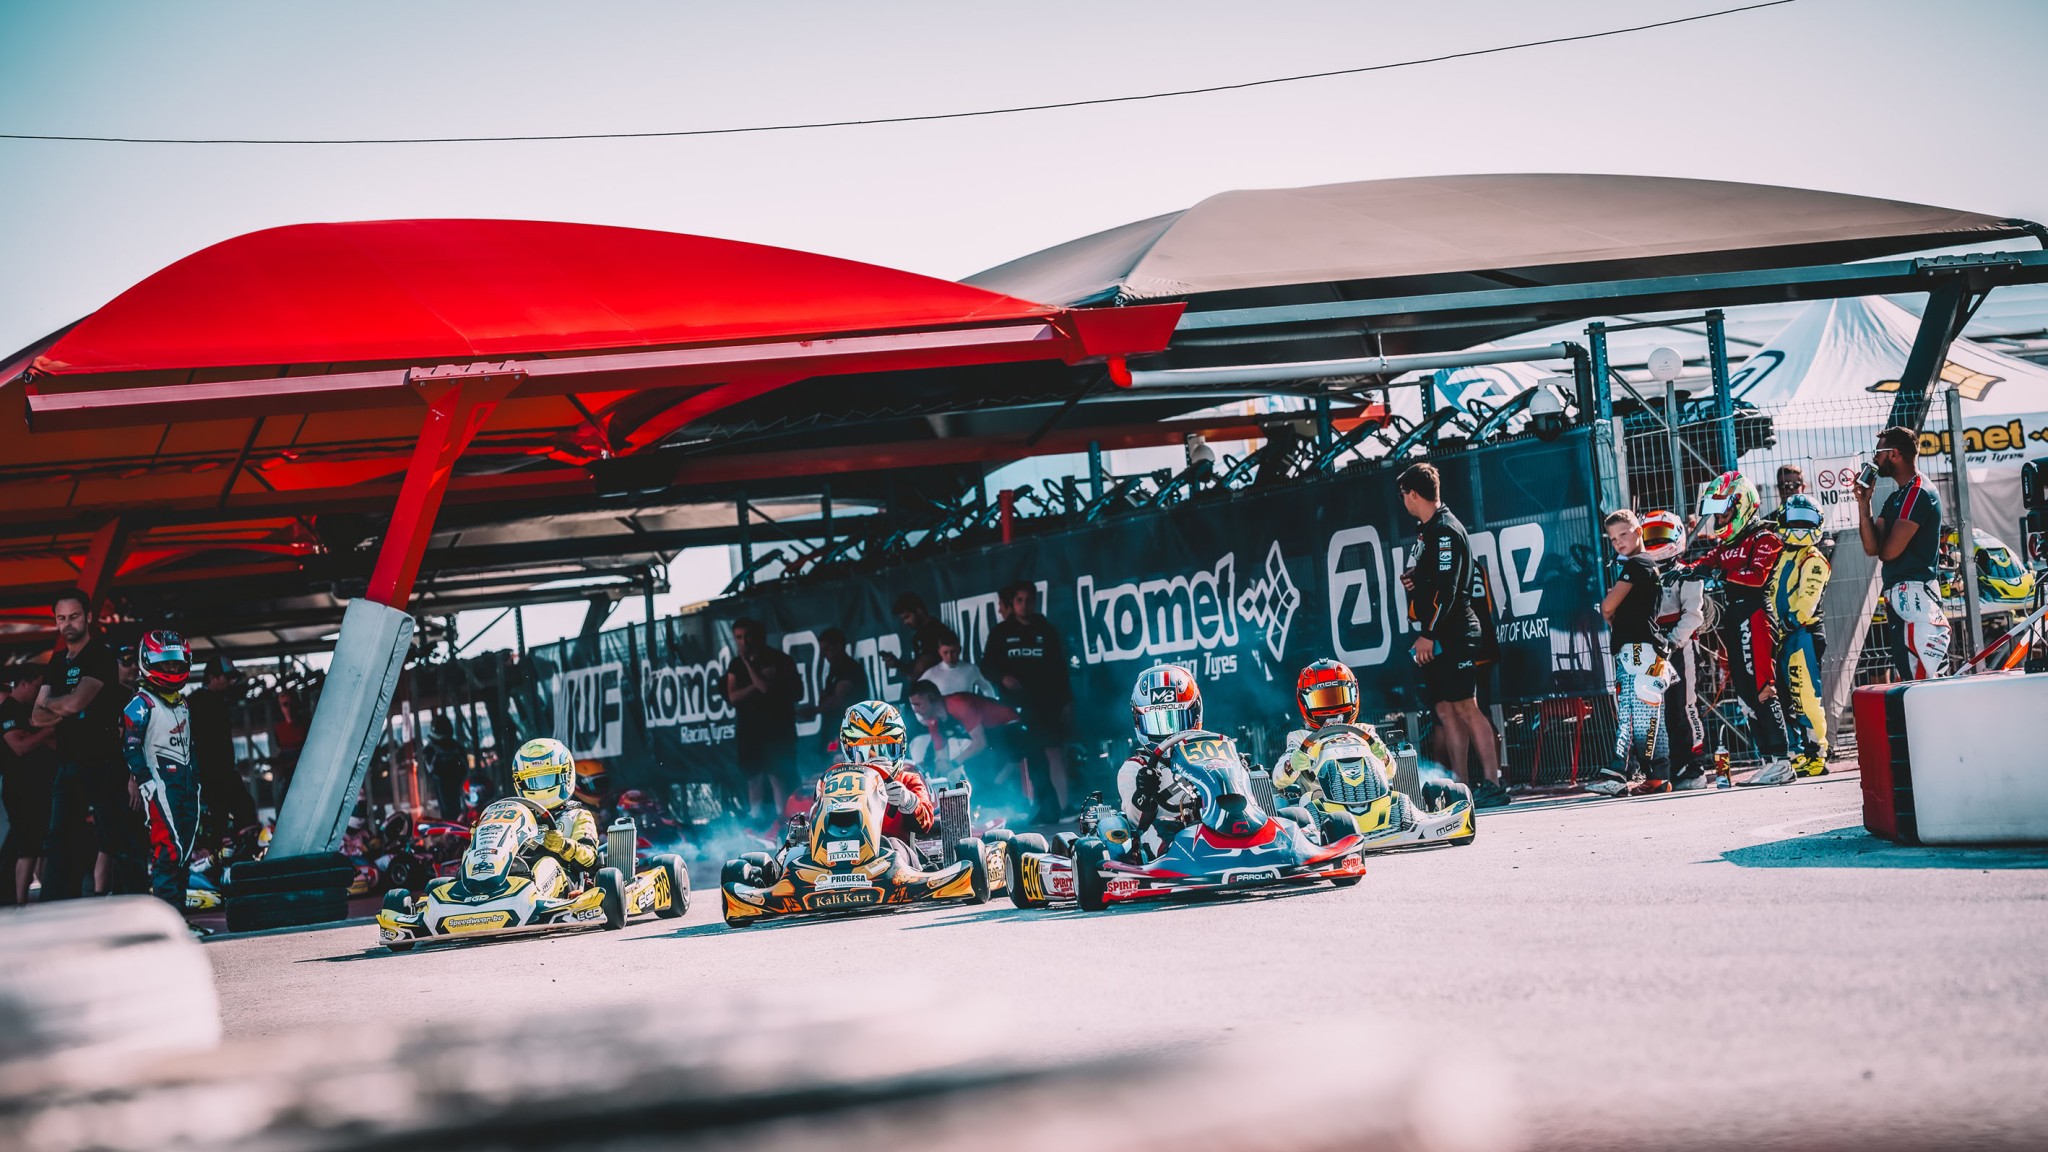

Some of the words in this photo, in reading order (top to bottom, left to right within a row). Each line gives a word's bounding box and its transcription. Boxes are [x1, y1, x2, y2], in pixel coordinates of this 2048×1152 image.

[1919, 418, 2026, 457] omet
[1991, 452, 2024, 462] Tyres
[1821, 489, 1838, 505] NO
[1077, 552, 1239, 664] komet
[1523, 617, 1550, 640] KART
[1203, 652, 1238, 681] Tyres
[681, 725, 712, 745] Racing
[710, 721, 735, 743] Tyres
[1184, 740, 1232, 762] 501
[825, 775, 865, 794] 541
[484, 809, 518, 820] 573
[829, 852, 859, 861] JELOMA
[831, 875, 866, 883] PROGESA
[1022, 857, 1041, 899] 501
[1053, 877, 1073, 889] SPIRIT
[1107, 879, 1140, 893] SPIRIT
[463, 894, 490, 903] EGP
[638, 886, 655, 909] EGP
[816, 896, 840, 907] Kali
[843, 894, 871, 904] Kart
[576, 908, 602, 921] EGP
[380, 929, 398, 939] EGP
